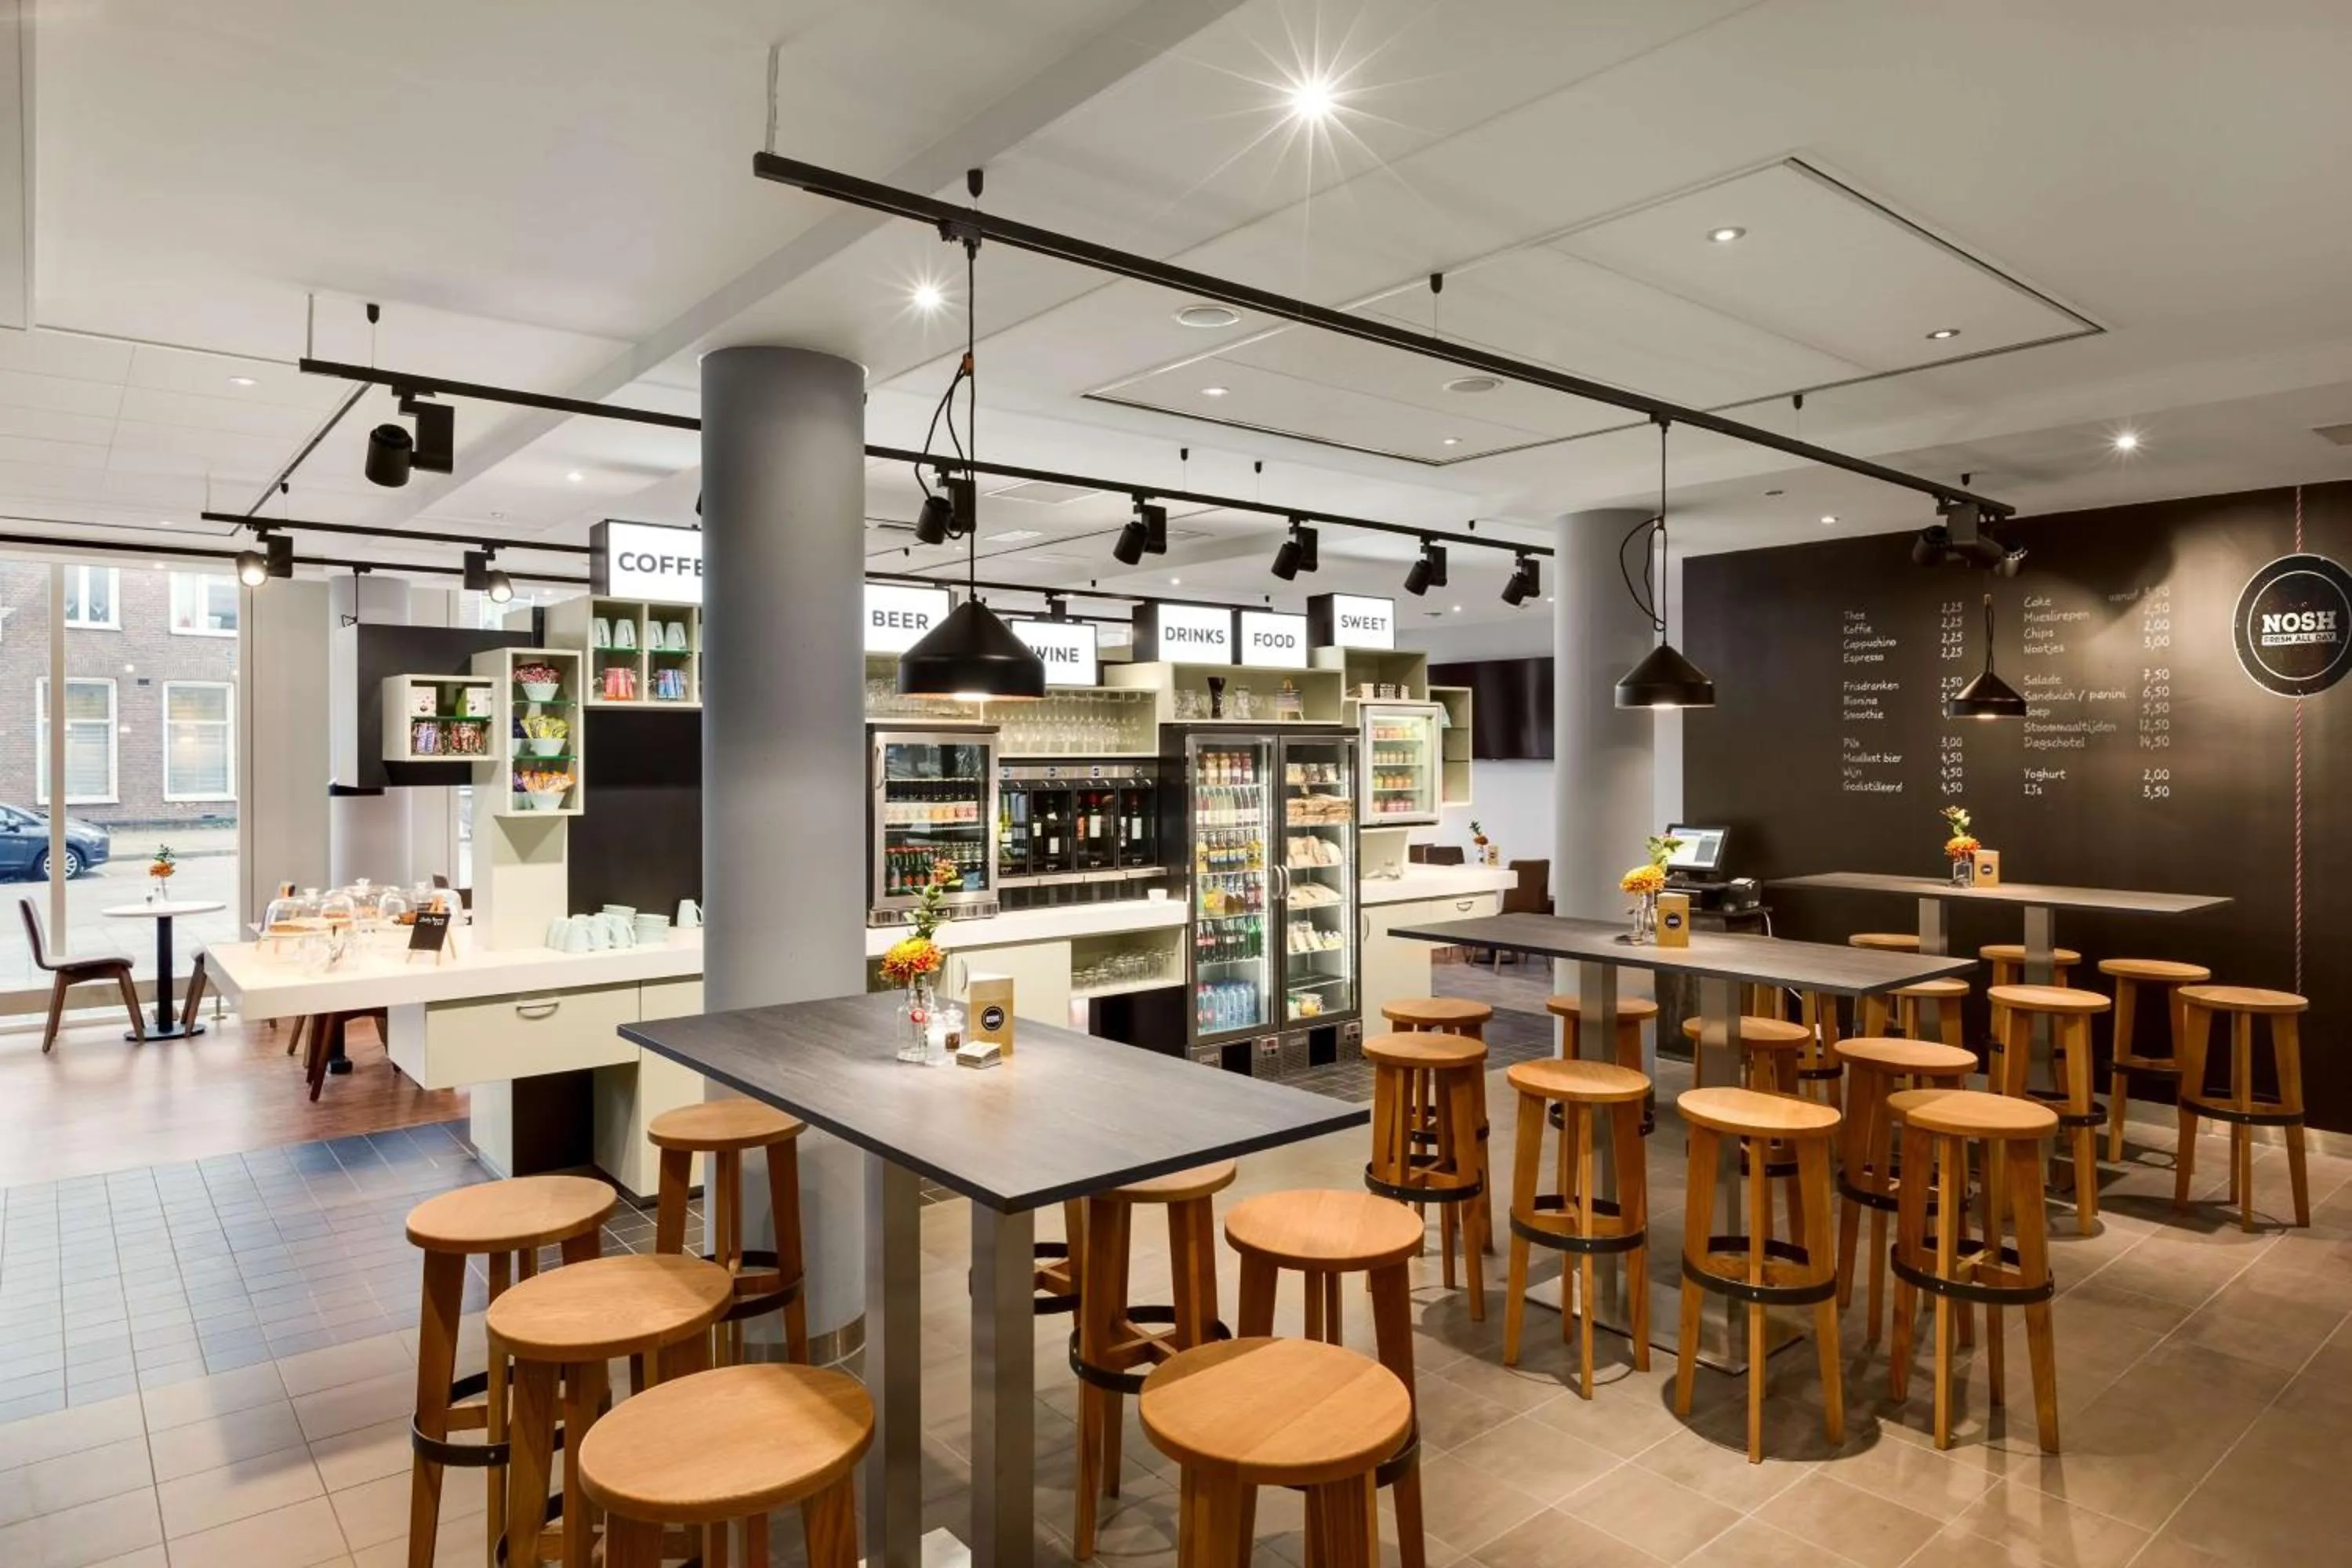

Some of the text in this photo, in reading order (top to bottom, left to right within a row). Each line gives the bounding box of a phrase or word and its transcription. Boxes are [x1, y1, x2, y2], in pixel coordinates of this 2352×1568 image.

[619, 552, 703, 577] COFFE
[872, 610, 928, 630] BEER
[1341, 614, 1388, 631] SWEET
[1844, 611, 1865, 620] Thee
[2024, 610, 2090, 622] Mueslirepen
[2262, 612, 2336, 633] NOSH
[1165, 626, 1225, 644] DRINKS
[1844, 623, 1872, 633] Koffie
[2024, 627, 2054, 641] Chips
[1254, 633, 1296, 648] FOOD
[2295, 633, 2312, 642] ALL
[2315, 633, 2334, 641] DAY
[1029, 644, 1080, 662] WINE
[2024, 643, 2065, 655] Nootjes
[1844, 653, 1884, 664] Espresso
[1844, 677, 1963, 691] Frisdranken 2,50
[2024, 673, 2063, 686] Salade
[2024, 685, 2170, 702] Sandwich / panini 6,50
[1844, 709, 1884, 720] Smoothie
[2024, 719, 2170, 734] Stoommaaltijden 12,50
[1843, 738, 1860, 748] Pils
[2024, 736, 2085, 750] Dagschotel
[1883, 753, 1902, 763] bier
[1940, 753, 1963, 765] 4,50
[1940, 768, 1963, 780] 4,50
[2024, 768, 2170, 782] Yoghurt 2,00
[1940, 782, 1963, 796] 4,50
